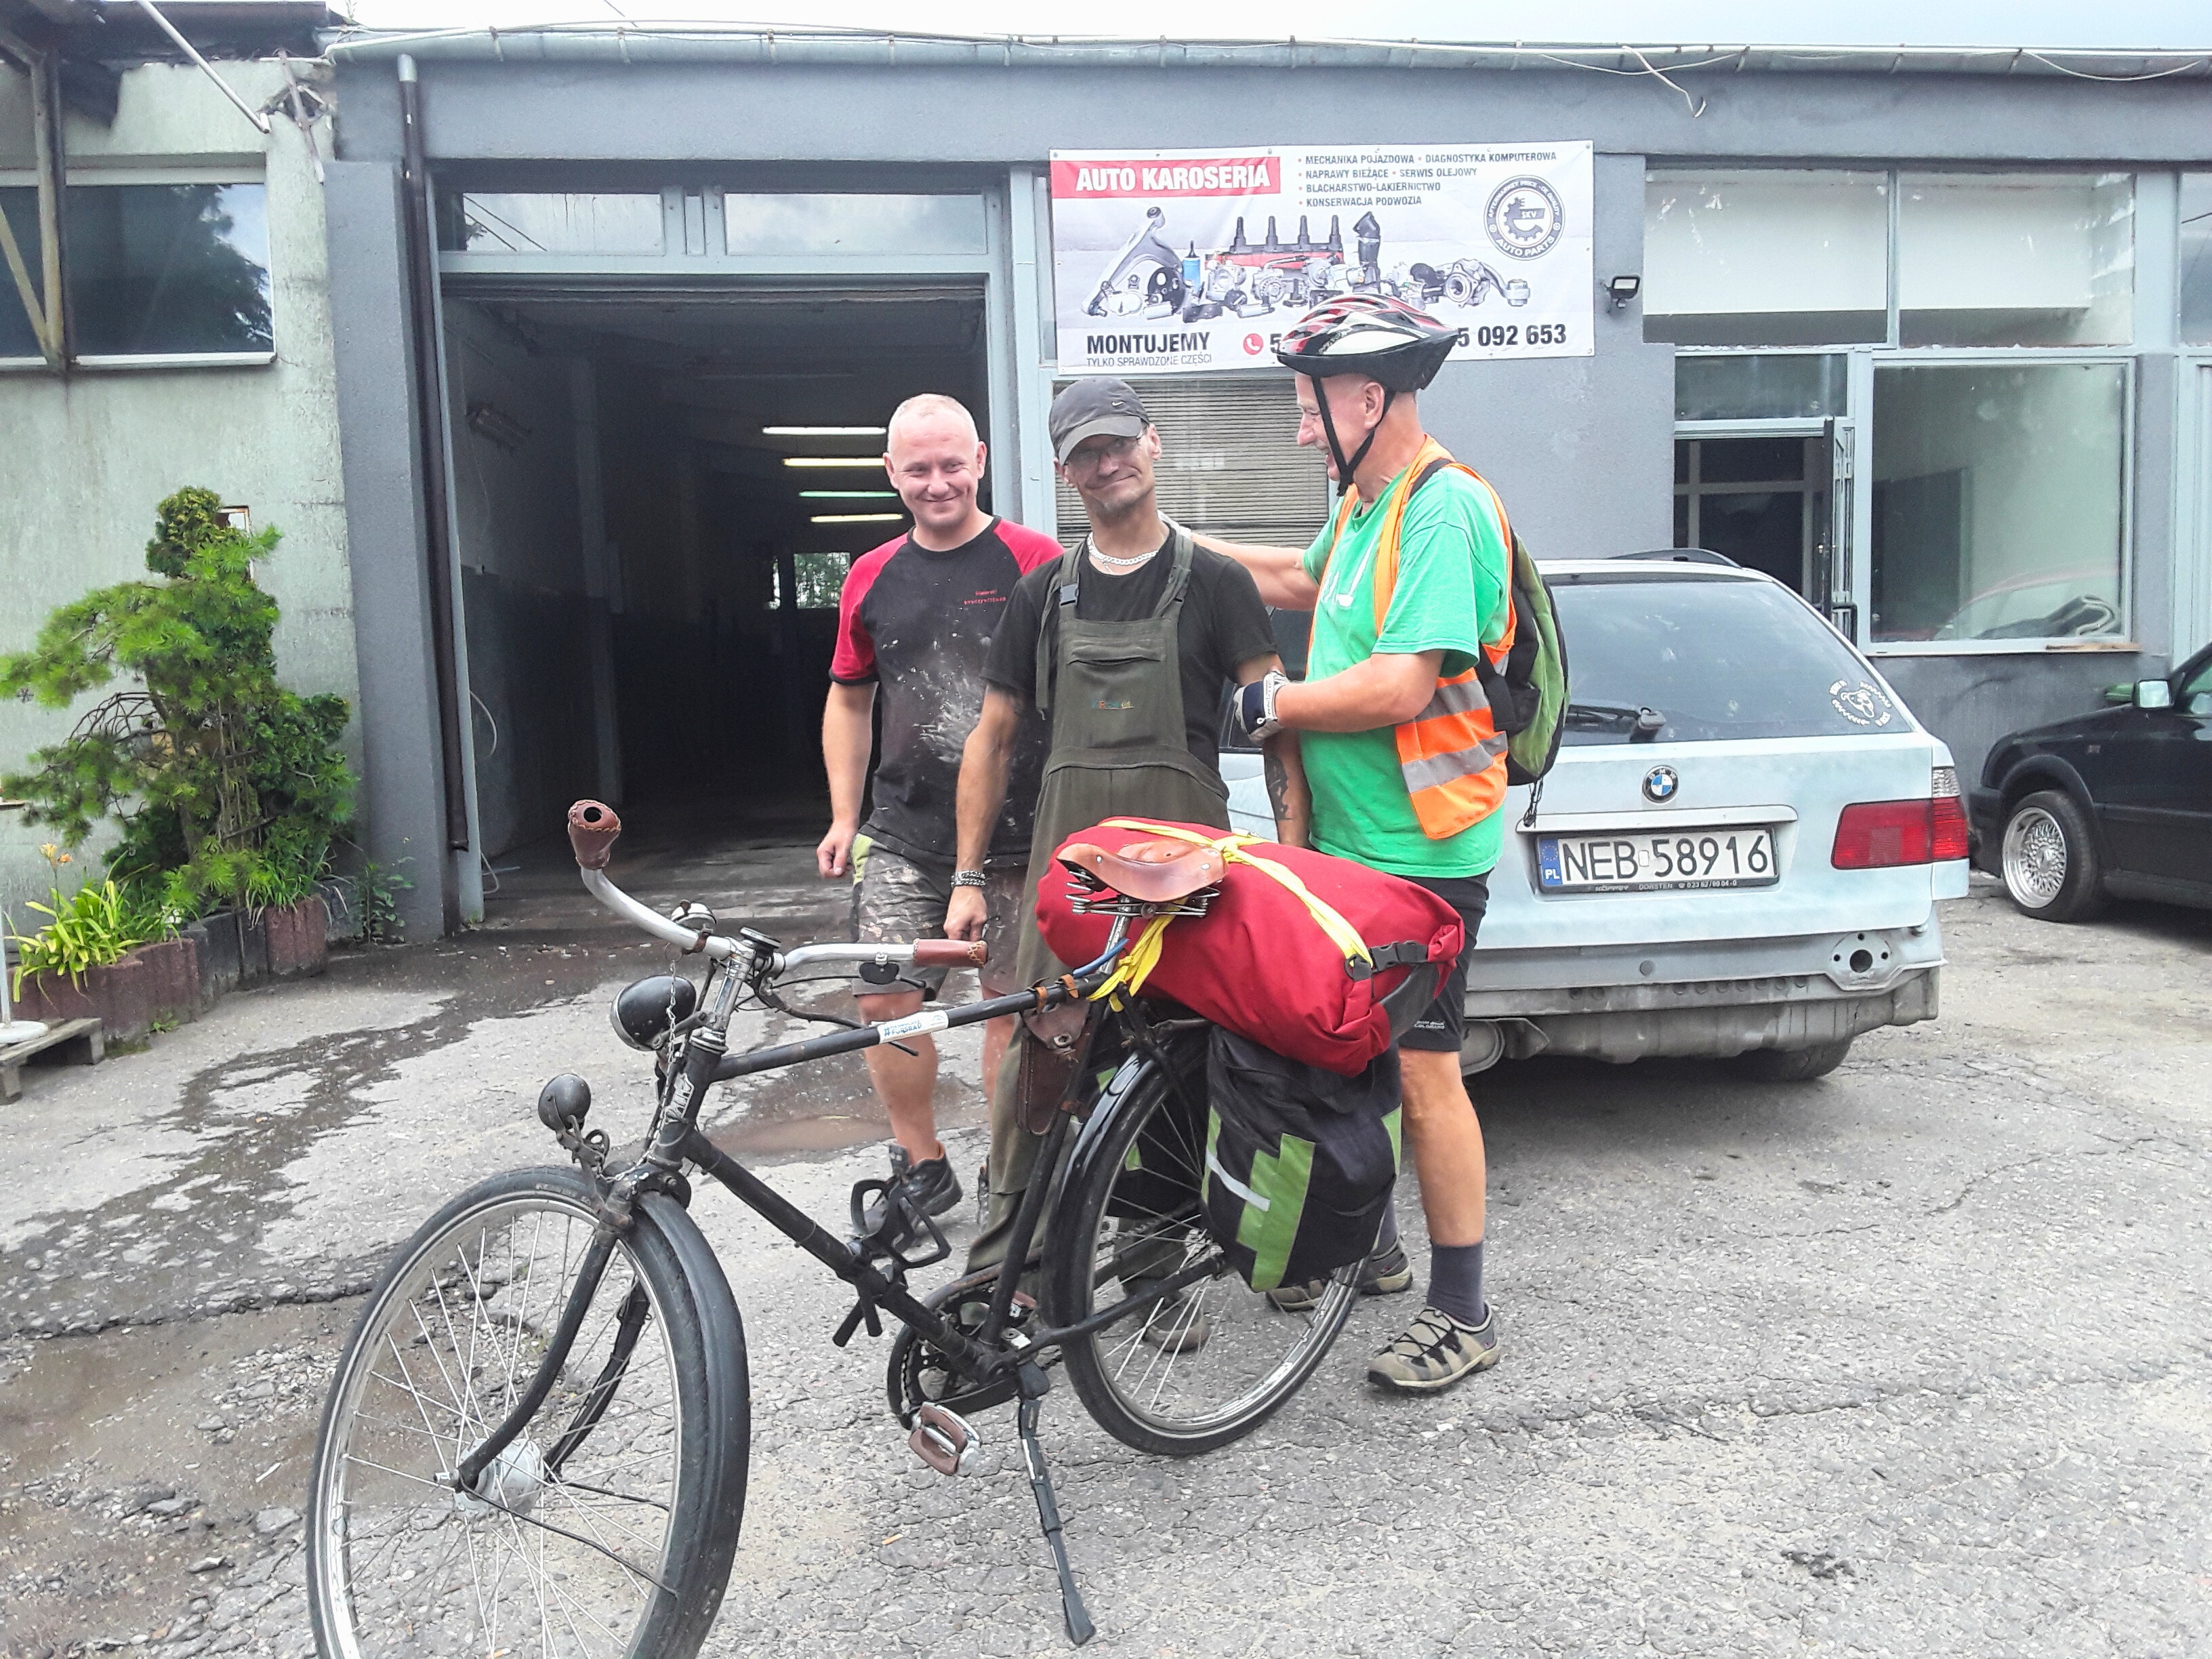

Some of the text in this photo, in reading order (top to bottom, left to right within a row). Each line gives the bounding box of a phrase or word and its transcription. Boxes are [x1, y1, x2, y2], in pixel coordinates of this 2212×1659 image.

[1305, 152, 1557, 165] MECHANIKA POJAZDOWA DIAGNOSTYKA KOMPUTEROWA
[1076, 164, 1271, 191] AUTO KAROSERIA
[1305, 167, 1477, 180] NAPRAWY BIEŻĄCE SERWIS OLEJOWY
[1306, 196, 1422, 207] KONSERWACJA PODWOZIA
[1496, 235, 1555, 256] AUTO PARTS
[1086, 331, 1210, 354] MONTUJEMY
[1477, 325, 1519, 346] 092
[1526, 323, 1567, 344] 653
[1086, 352, 1212, 367] TYLKO SPRAWDZONE CZĘŚCI
[1648, 769, 1677, 780] BMW
[1545, 835, 1768, 882] PL NEB 58916
